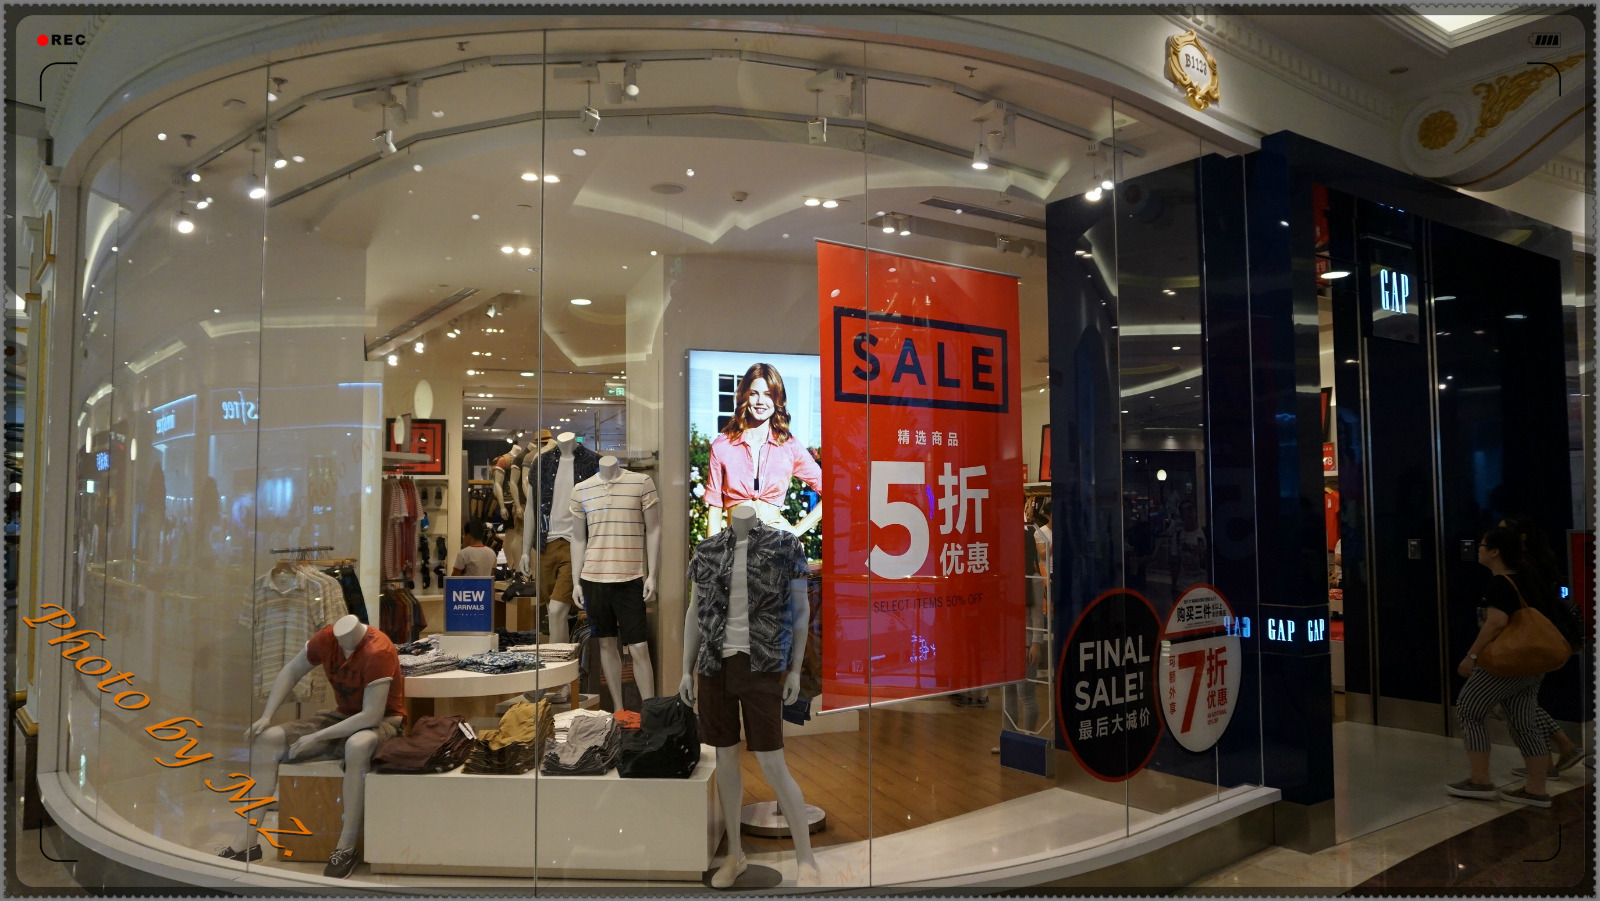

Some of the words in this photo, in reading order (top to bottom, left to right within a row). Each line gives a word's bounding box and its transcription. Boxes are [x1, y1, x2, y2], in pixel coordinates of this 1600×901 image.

[1380, 268, 1409, 314] GAP
[852, 332, 995, 392] SALE
[897, 429, 959, 447] 精选商品
[939, 542, 989, 577] 优惠
[452, 590, 485, 602] NEW
[873, 599, 910, 614] SELECT
[913, 597, 943, 610] ITEMS
[946, 595, 966, 607] 50%
[968, 593, 983, 606] OFF
[1177, 603, 1212, 623] 购买三件
[1308, 616, 1325, 642] GAP
[1268, 618, 1295, 642] GAP
[1079, 634, 1150, 672] FINAL
[1075, 670, 1144, 711] SALE!
[1168, 655, 1177, 715] 可额外享
[1178, 650, 1206, 734] 7
[1207, 688, 1228, 709] 优惠
[1078, 708, 1151, 741] 最后大减价
